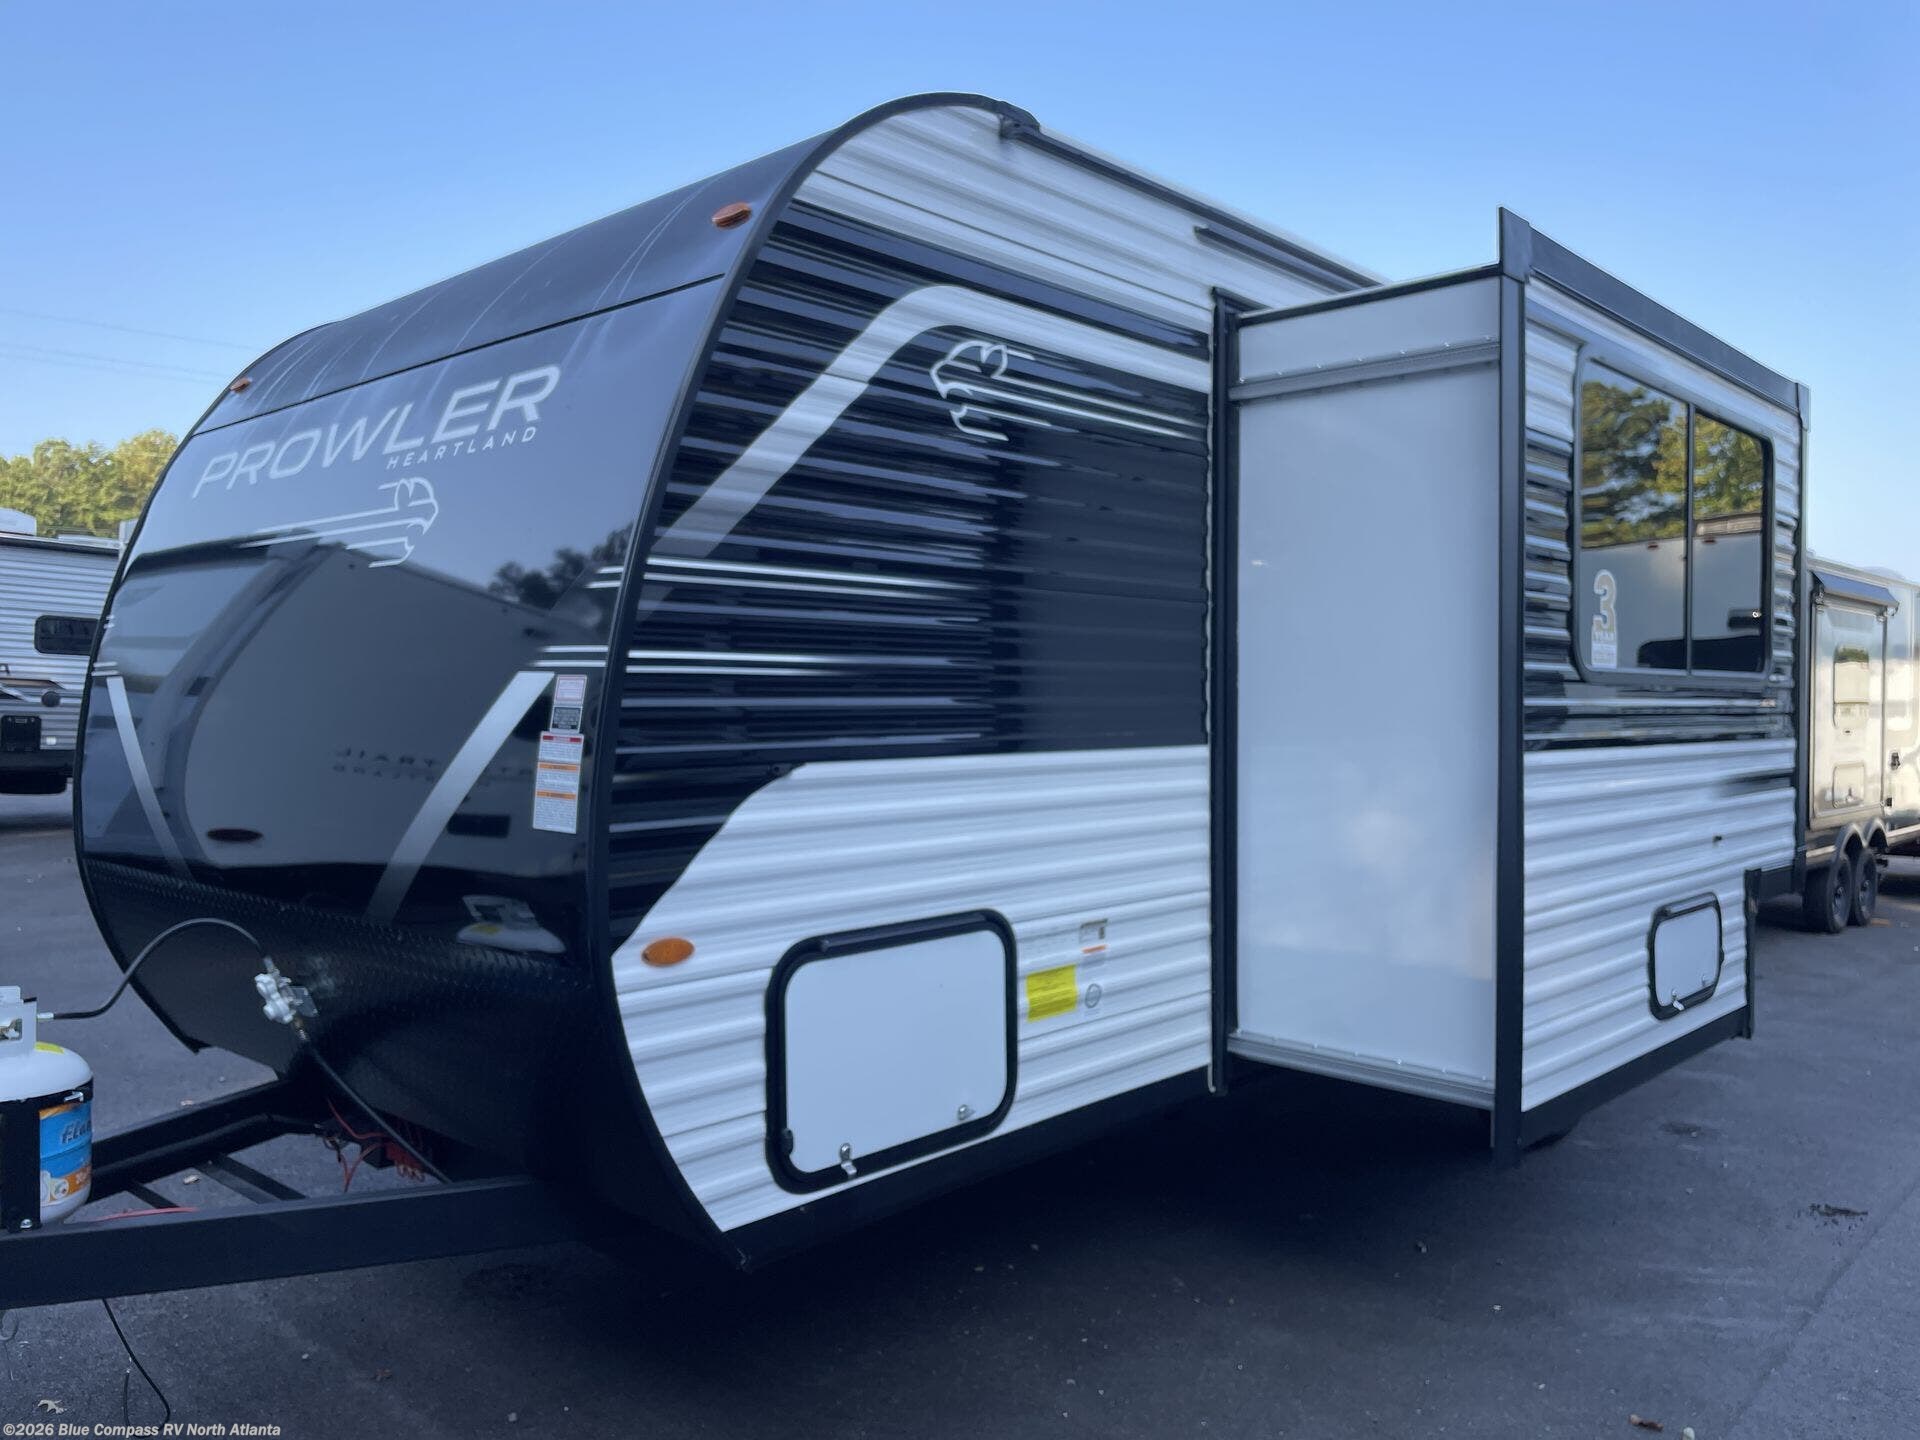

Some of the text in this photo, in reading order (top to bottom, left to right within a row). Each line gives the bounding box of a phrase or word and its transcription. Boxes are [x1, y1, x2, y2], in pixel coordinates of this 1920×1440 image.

[191, 363, 561, 499] PROWLER
[386, 426, 538, 470] HEARTLAND
[1593, 569, 1617, 632] 3
